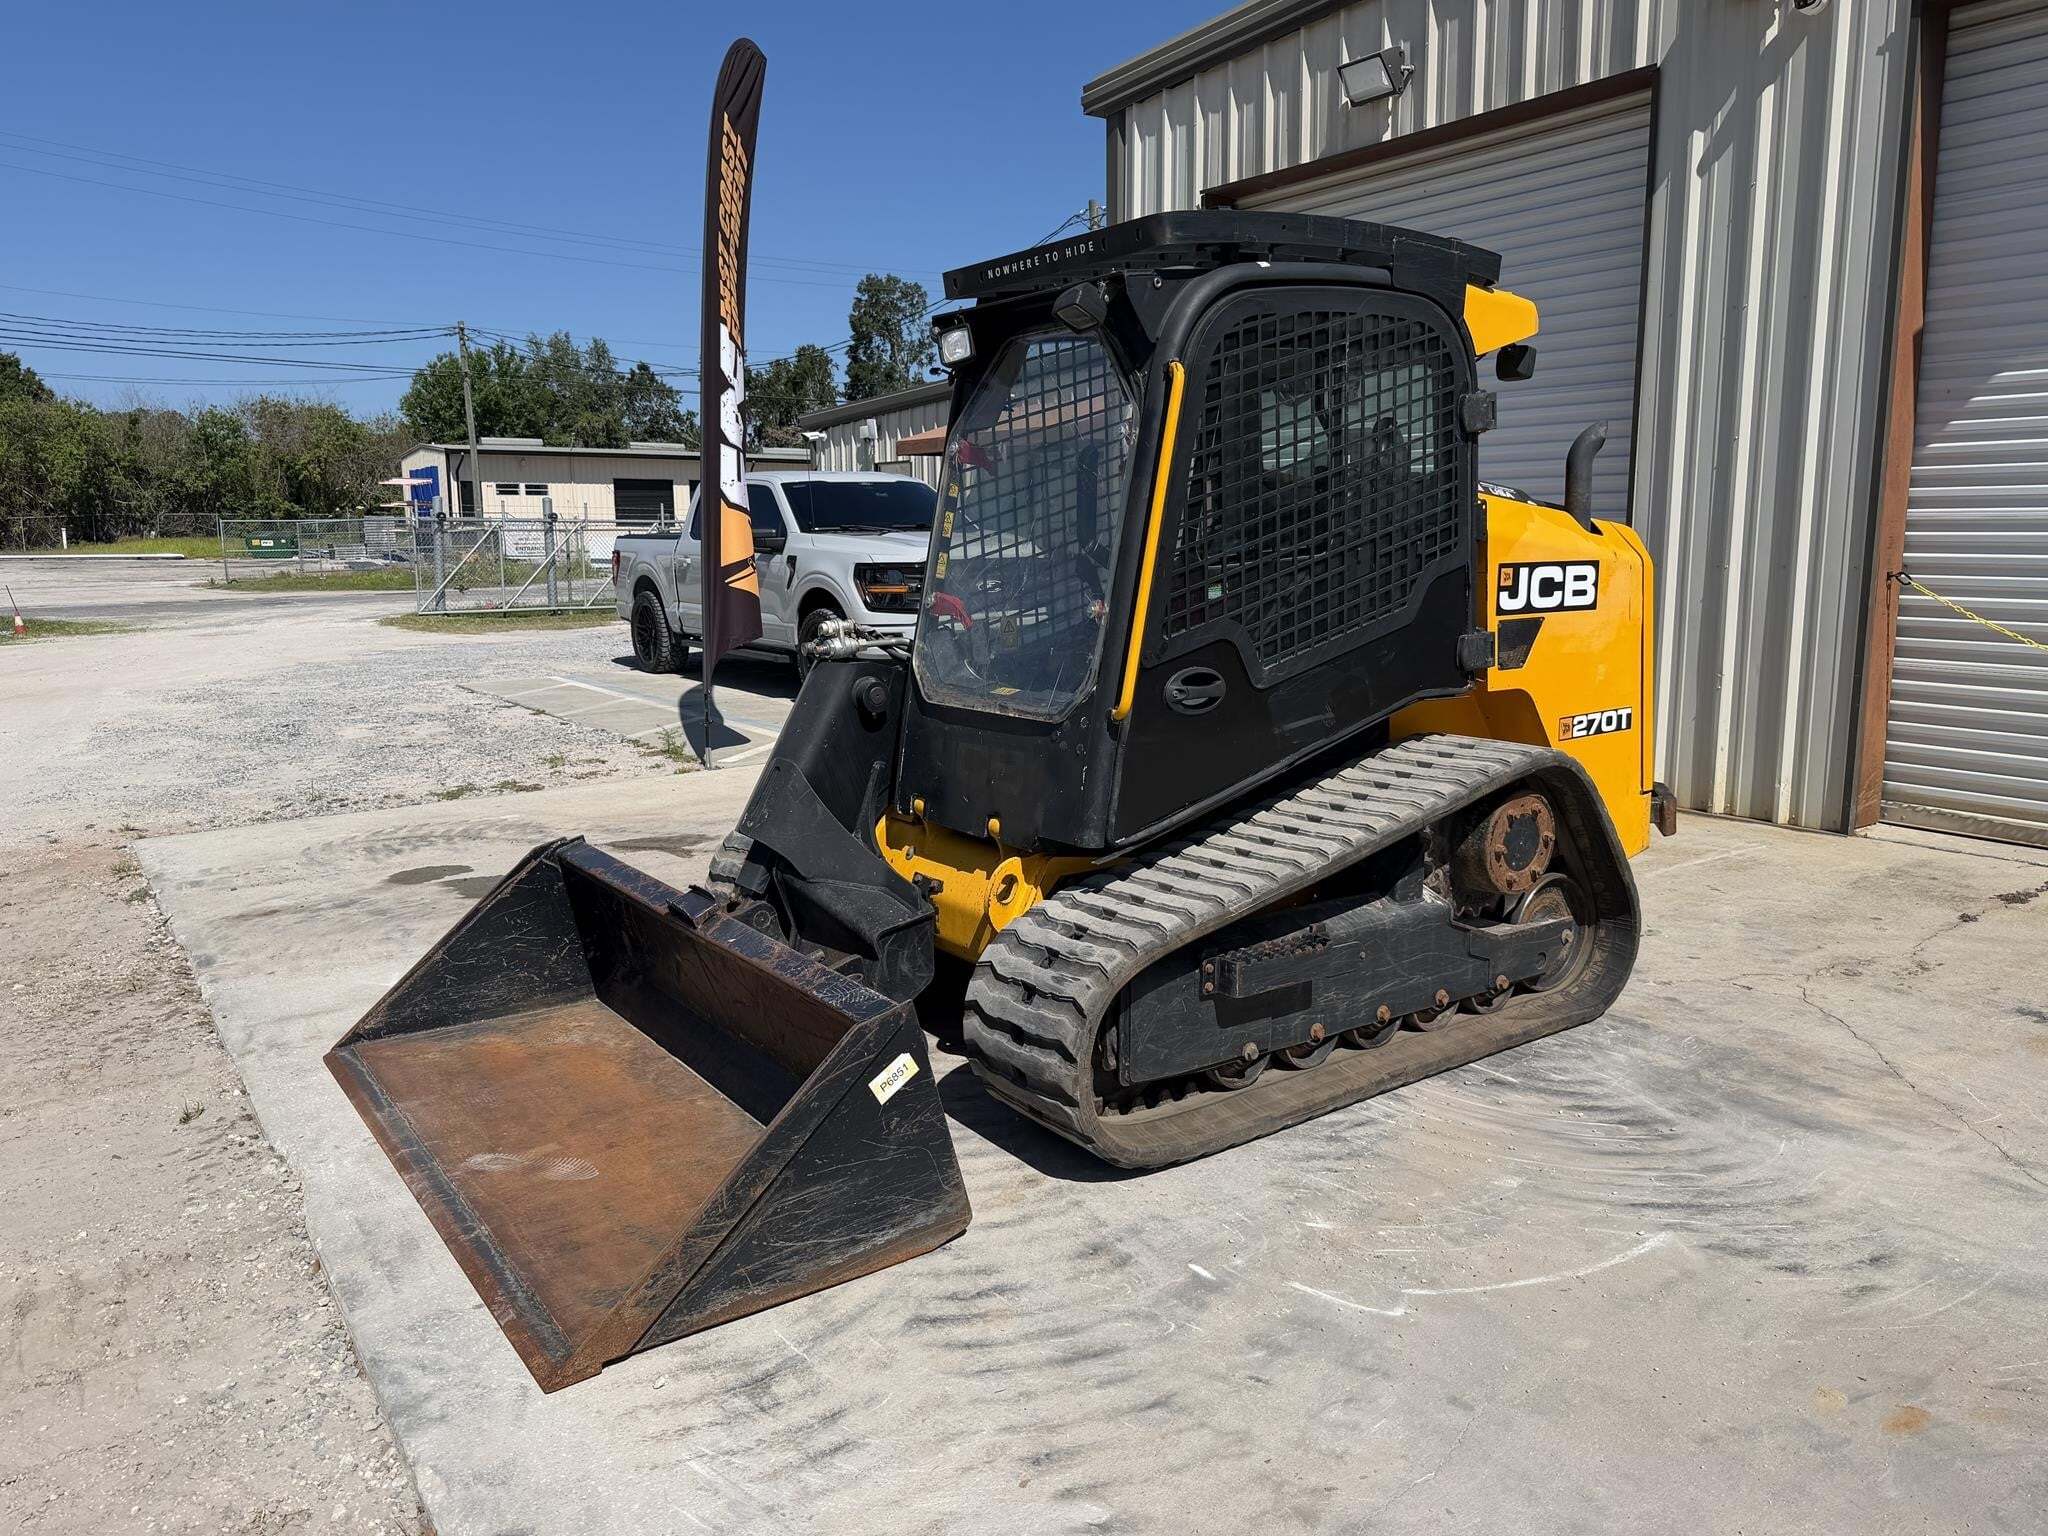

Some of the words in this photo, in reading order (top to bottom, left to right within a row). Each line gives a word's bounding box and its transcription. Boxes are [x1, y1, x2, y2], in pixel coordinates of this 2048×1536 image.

[719, 111, 737, 240] COAST
[987, 256, 1040, 279] NOWHERE
[1045, 251, 1059, 264] TO
[1065, 240, 1094, 259] HIDE
[1499, 565, 1596, 611] JCB
[1572, 708, 1631, 737] 270T
[880, 1063, 909, 1092] P6851
